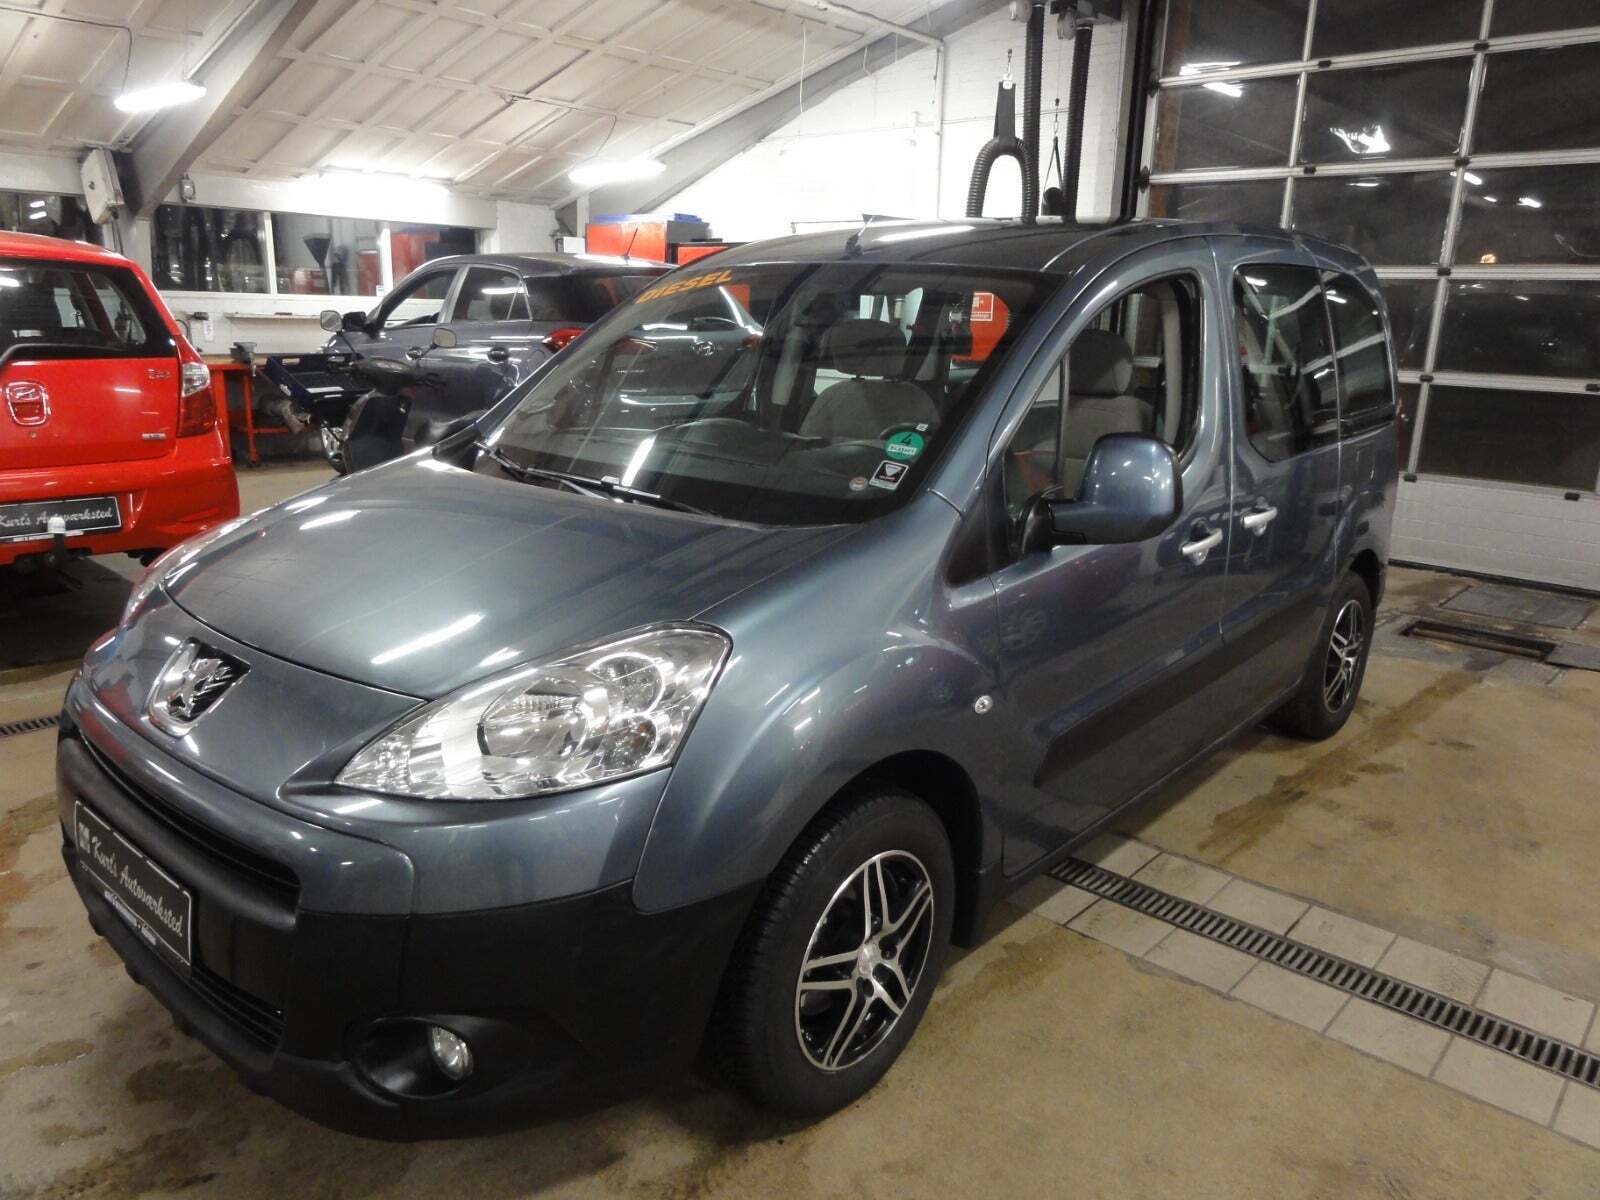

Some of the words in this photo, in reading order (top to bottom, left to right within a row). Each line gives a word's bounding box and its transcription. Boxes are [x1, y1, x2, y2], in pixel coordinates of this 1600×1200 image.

[634, 269, 732, 304] DIESEL
[901, 433, 912, 445] 4
[36, 507, 113, 526] Aværksted
